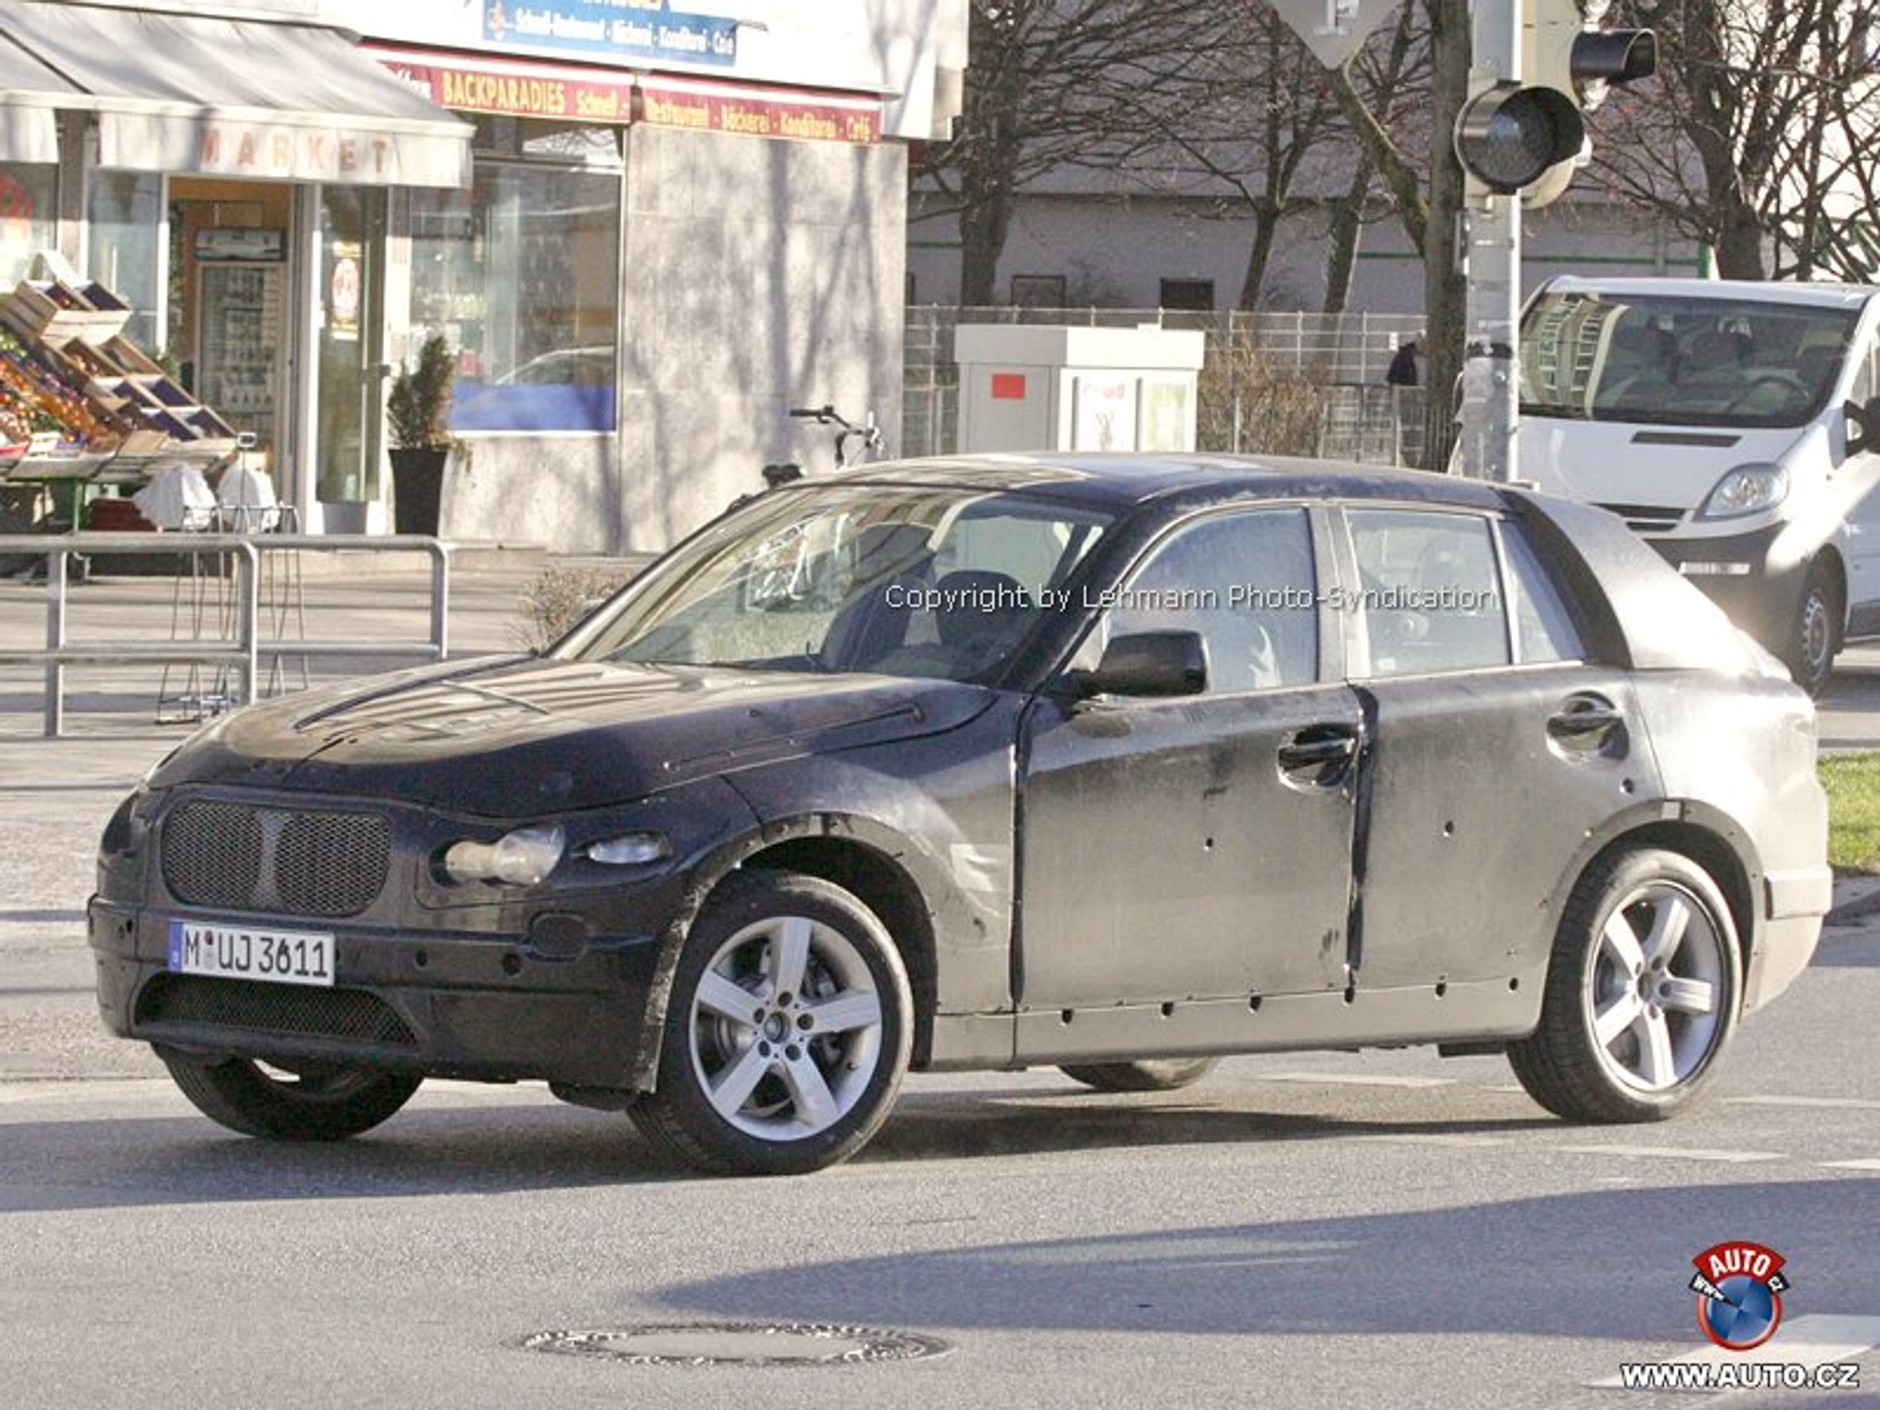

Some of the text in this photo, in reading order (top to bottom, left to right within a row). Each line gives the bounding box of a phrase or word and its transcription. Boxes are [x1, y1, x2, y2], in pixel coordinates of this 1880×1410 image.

[442, 71, 566, 114] BACKPARADIES
[198, 127, 388, 173] MARKET
[185, 930, 199, 967] M
